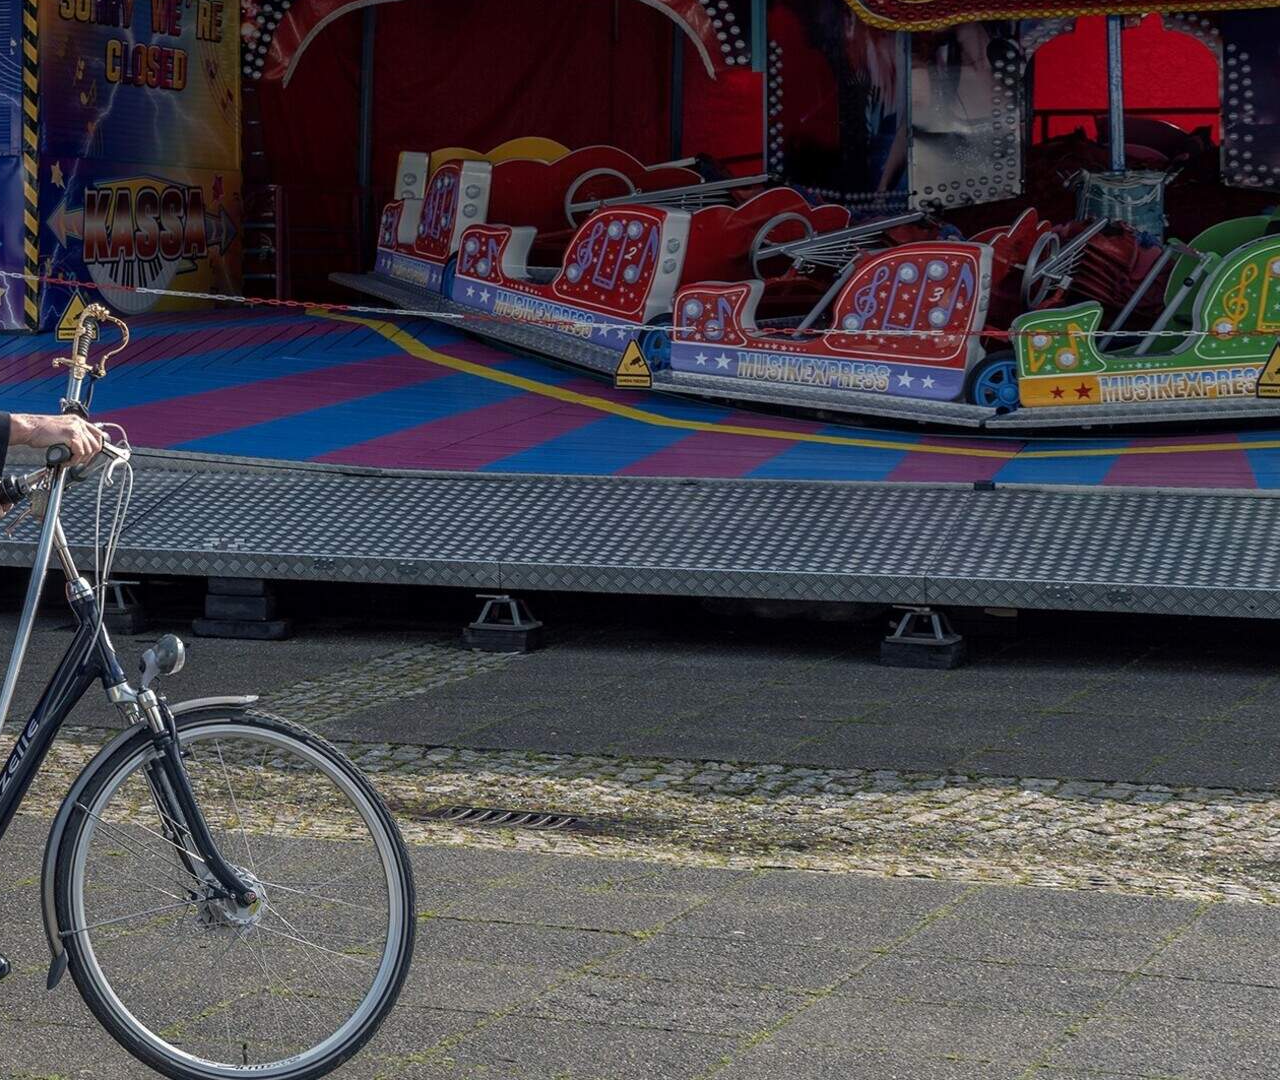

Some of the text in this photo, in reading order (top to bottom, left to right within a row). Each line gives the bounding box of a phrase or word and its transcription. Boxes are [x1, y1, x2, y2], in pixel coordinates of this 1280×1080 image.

[105, 38, 188, 91] CLOSED
[83, 186, 208, 263] KASSA
[624, 247, 637, 260] 2
[928, 287, 944, 301] 3
[736, 351, 892, 392] MUSIKEXPRESS
